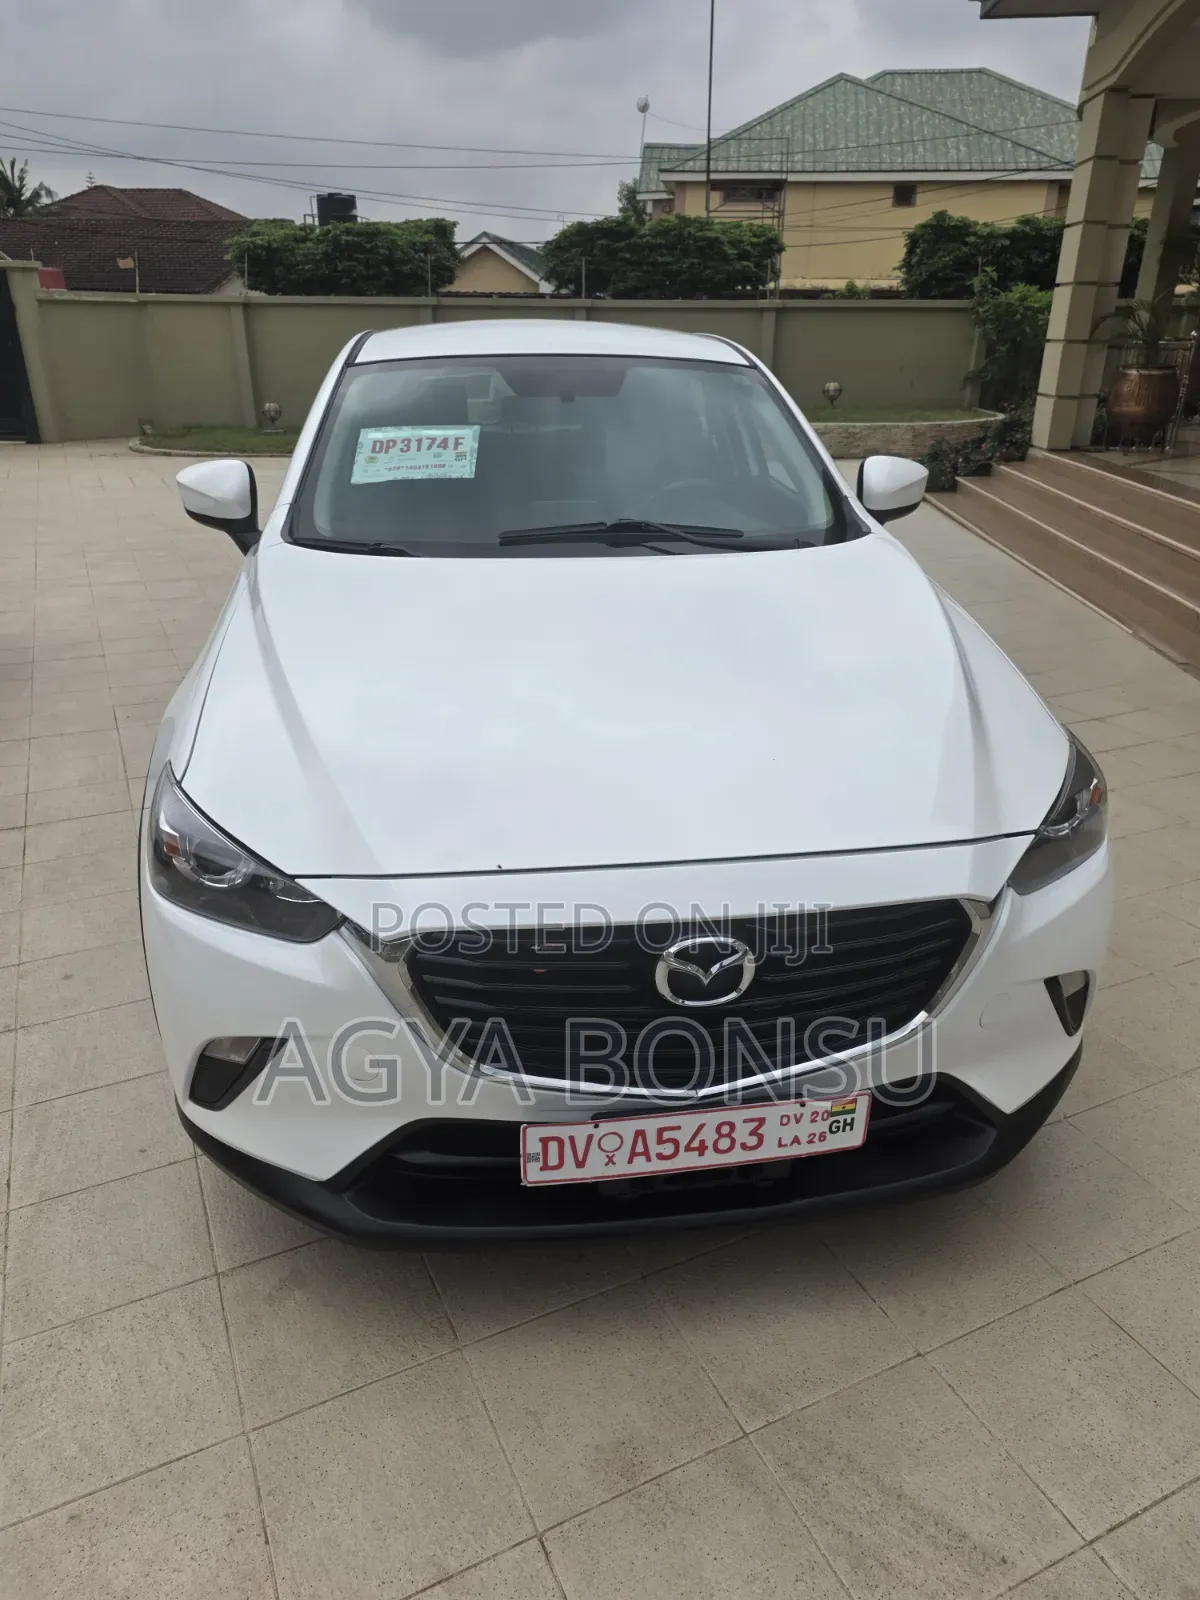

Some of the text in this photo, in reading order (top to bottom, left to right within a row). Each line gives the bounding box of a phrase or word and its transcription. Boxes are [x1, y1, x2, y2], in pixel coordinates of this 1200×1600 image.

[371, 437, 465, 454] DP 3174 F
[779, 1109, 830, 1127] DV 20
[828, 1116, 855, 1135] GH
[539, 1117, 767, 1172] DV A5483
[777, 1131, 827, 1148] LA 26
